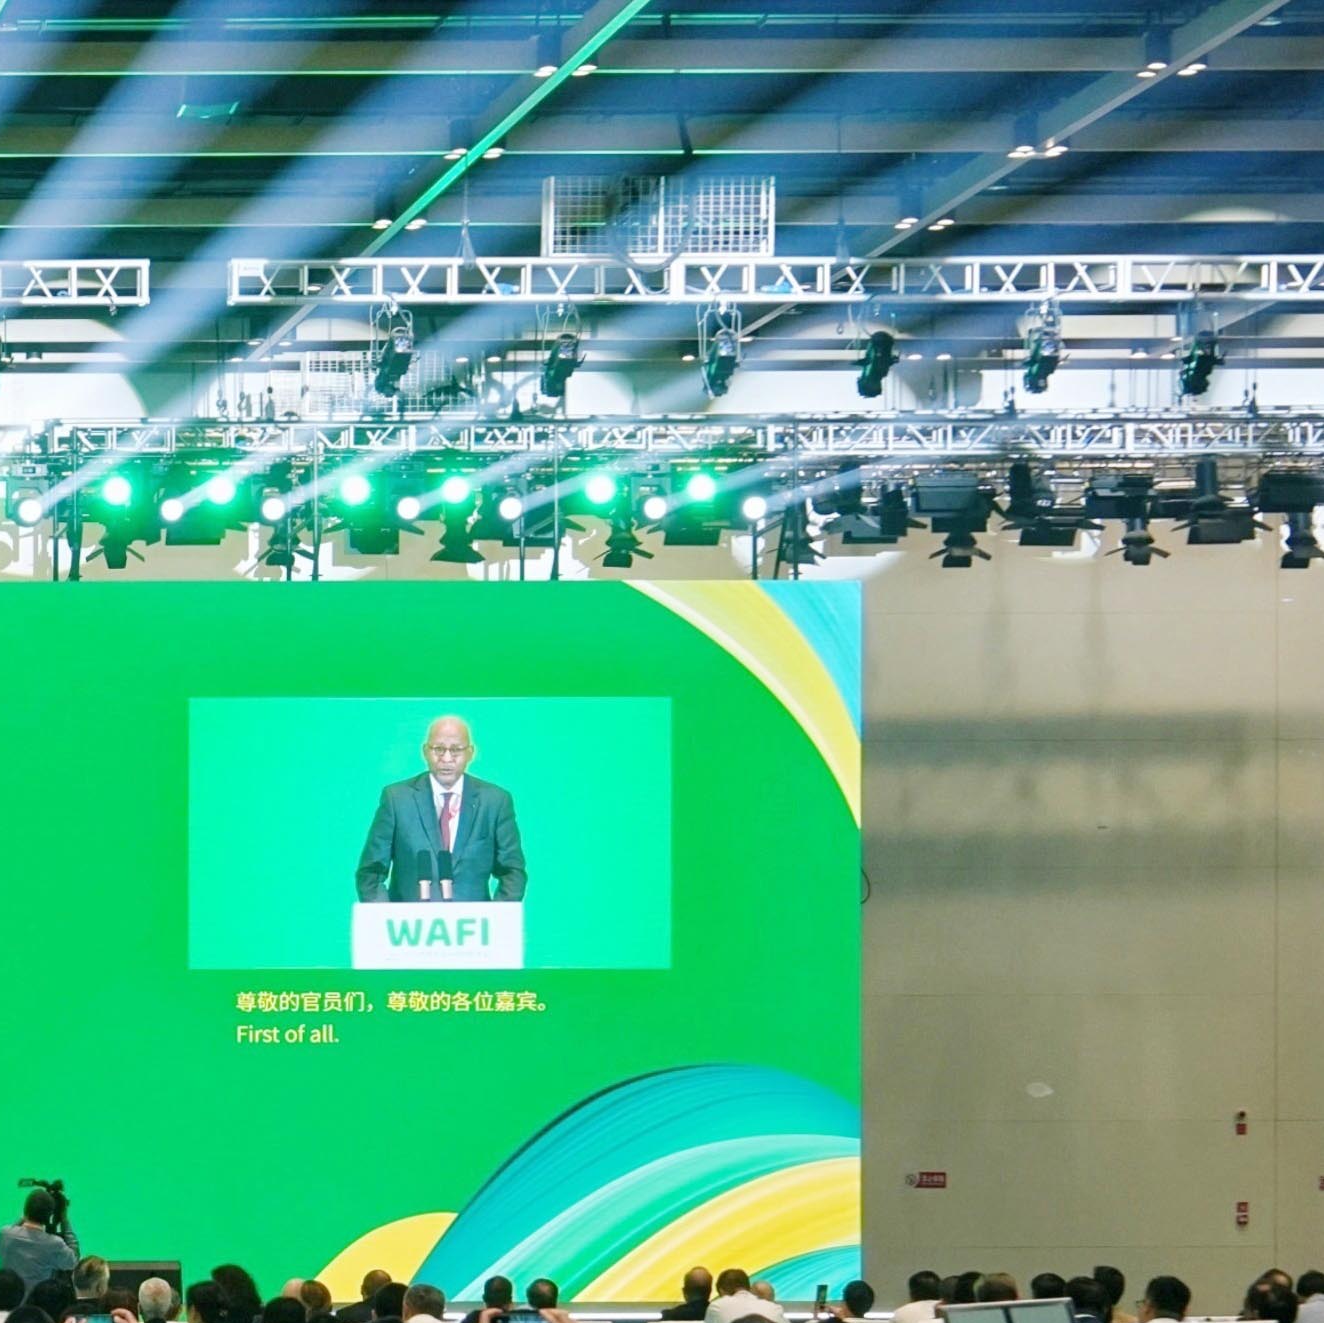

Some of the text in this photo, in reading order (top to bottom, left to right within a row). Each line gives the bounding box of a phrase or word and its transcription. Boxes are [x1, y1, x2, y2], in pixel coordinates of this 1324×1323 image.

[386, 917, 490, 947] WAFI
[236, 1023, 340, 1044] First of all.
